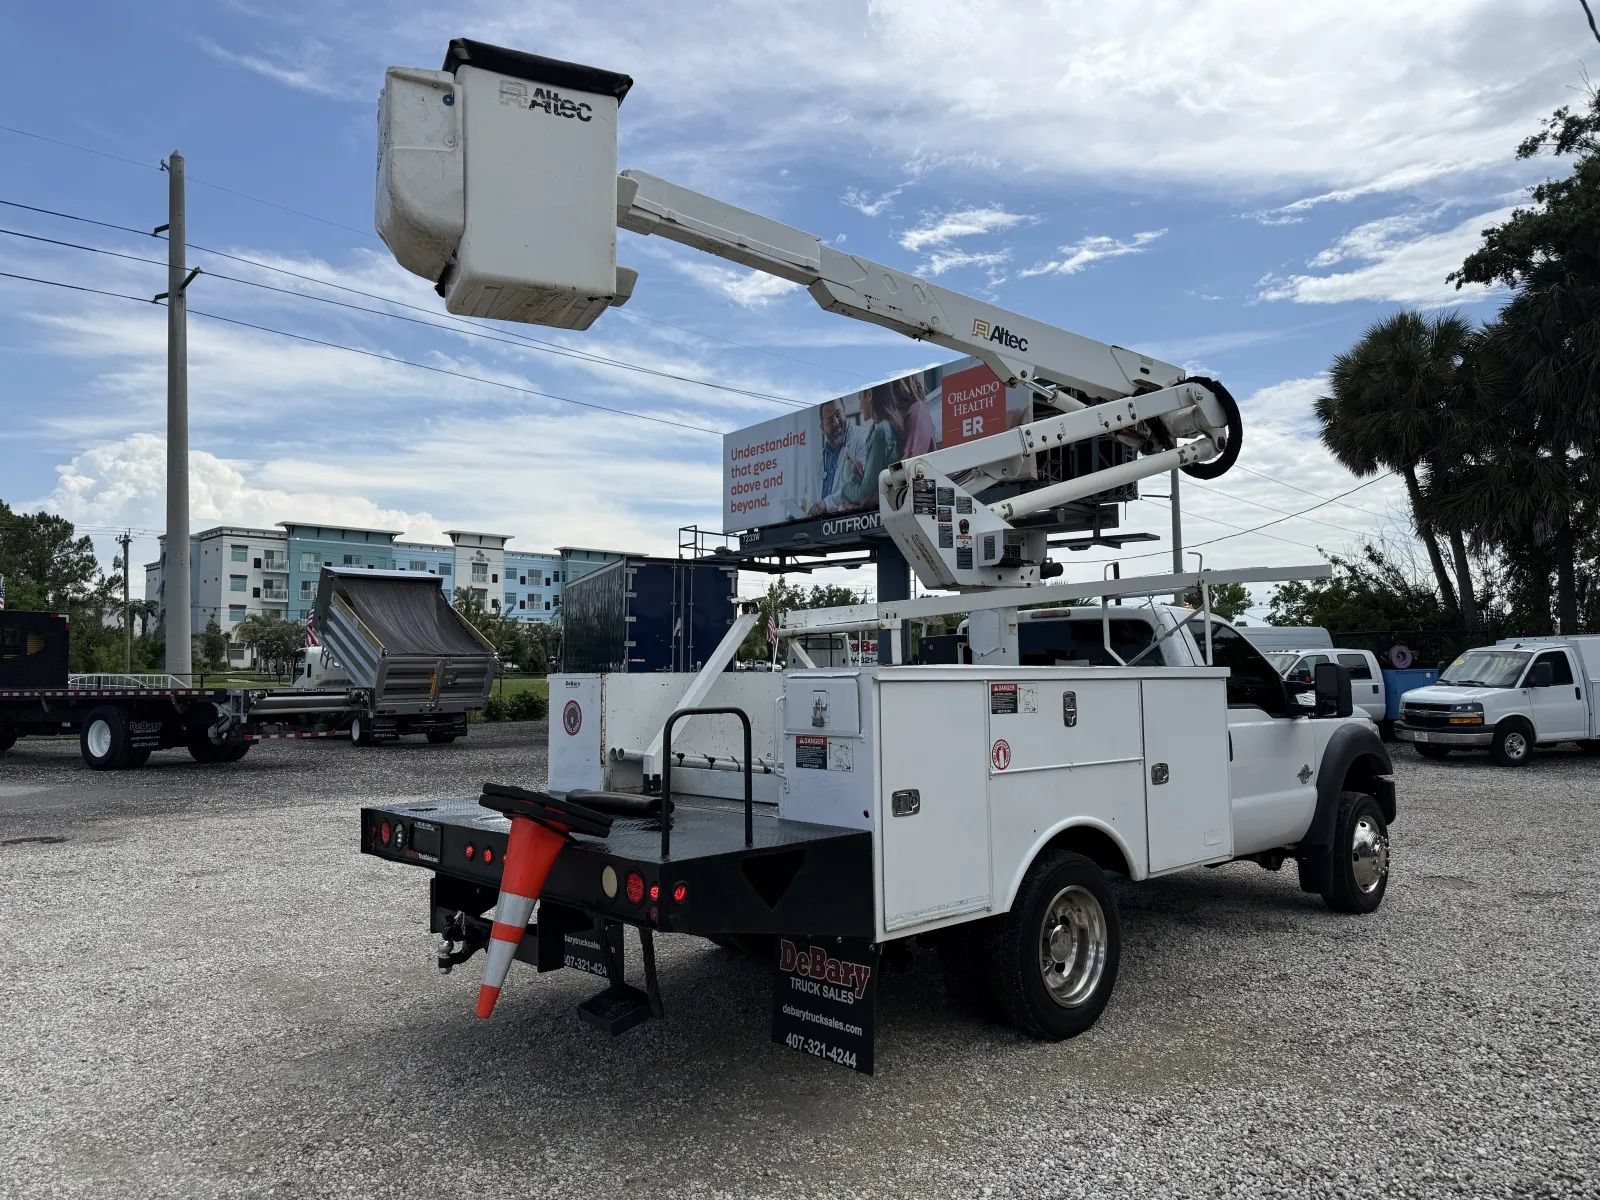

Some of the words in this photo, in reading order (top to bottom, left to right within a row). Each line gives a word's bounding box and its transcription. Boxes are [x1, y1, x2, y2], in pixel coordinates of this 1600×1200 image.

[529, 87, 593, 122] Altec
[989, 325, 1029, 352] Altec
[947, 381, 1000, 405] ORLANDO
[953, 396, 993, 417] HEALTH
[962, 415, 984, 438] ER
[731, 431, 806, 461] Understanding
[731, 463, 752, 479] that
[753, 458, 778, 476] goes
[731, 480, 761, 496] above
[762, 471, 784, 489] and
[731, 493, 770, 515] beyond.
[780, 939, 871, 999] DeBary
[789, 976, 820, 996] TRUCK
[822, 985, 854, 1005] SALES
[782, 1003, 863, 1036] debarytrucksales.com
[785, 1032, 857, 1068] 407-321-4244
